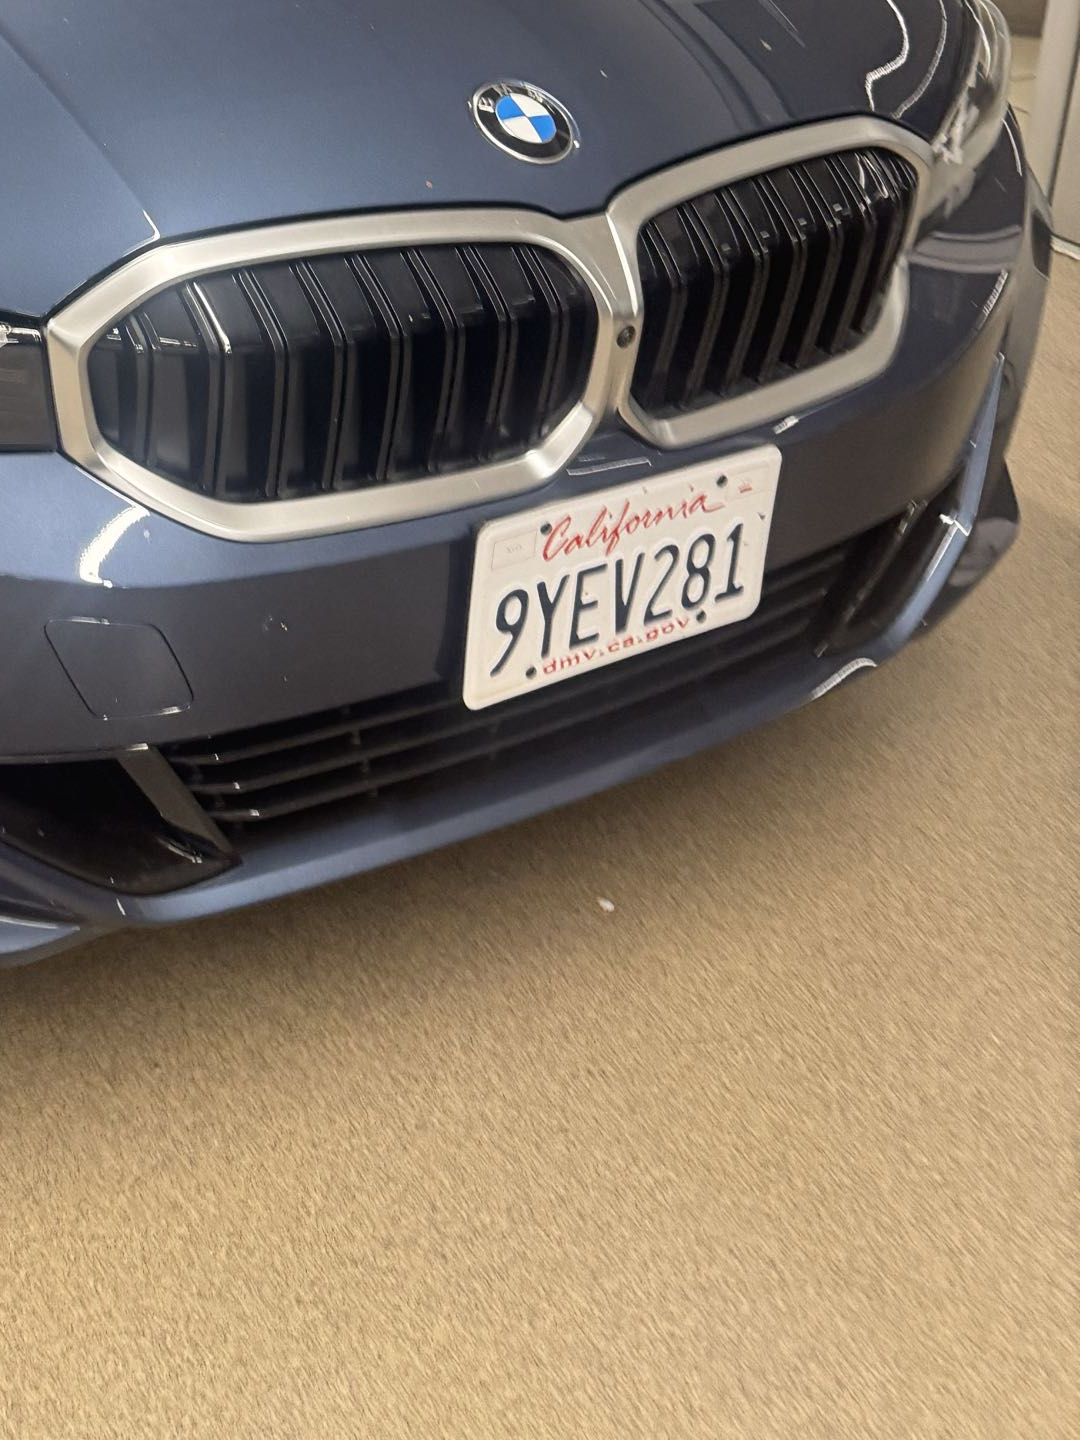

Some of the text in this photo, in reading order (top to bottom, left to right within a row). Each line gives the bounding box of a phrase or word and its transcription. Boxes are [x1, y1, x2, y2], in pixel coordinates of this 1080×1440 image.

[542, 485, 726, 561] California
[489, 522, 745, 678] 9YEV281
[542, 616, 690, 675] dmv.ca.gov
